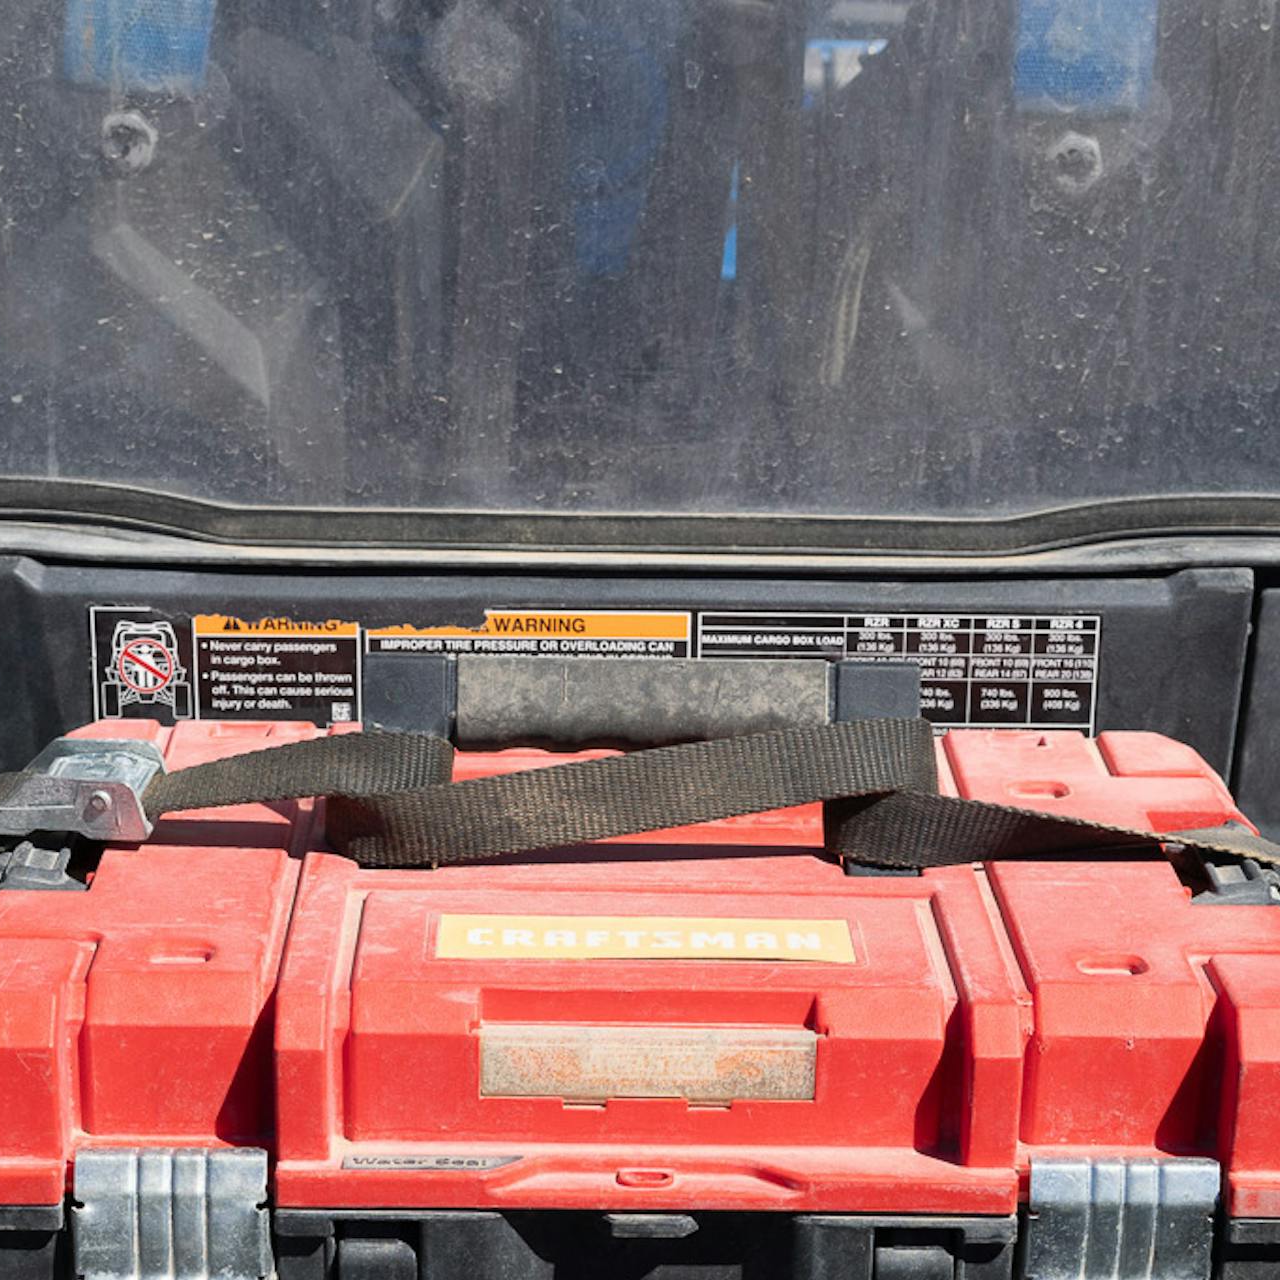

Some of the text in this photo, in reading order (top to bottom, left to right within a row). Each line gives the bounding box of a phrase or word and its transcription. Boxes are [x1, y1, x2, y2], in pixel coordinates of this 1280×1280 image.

[493, 617, 586, 633] WARNING
[864, 617, 890, 628] RZR
[917, 618, 941, 628] RZR
[986, 619, 1010, 629] RZR
[1049, 620, 1074, 629] RZR
[380, 639, 675, 652] IMPROPER TIRE PRESSURE OR OVERLOADING CAN
[702, 634, 844, 647] MAXIMUM CARGO BOX LOAD
[210, 640, 337, 655] Never carry passengers
[211, 655, 281, 667] in cargo box.
[211, 671, 353, 684] Passengers can be thrown
[974, 668, 999, 678] REAR
[1034, 669, 1060, 679] REAR
[211, 685, 354, 697] off. This can cause serious
[980, 688, 998, 698] 740
[211, 699, 292, 711] injury or death.
[466, 926, 823, 951] CRAFTSMAN
